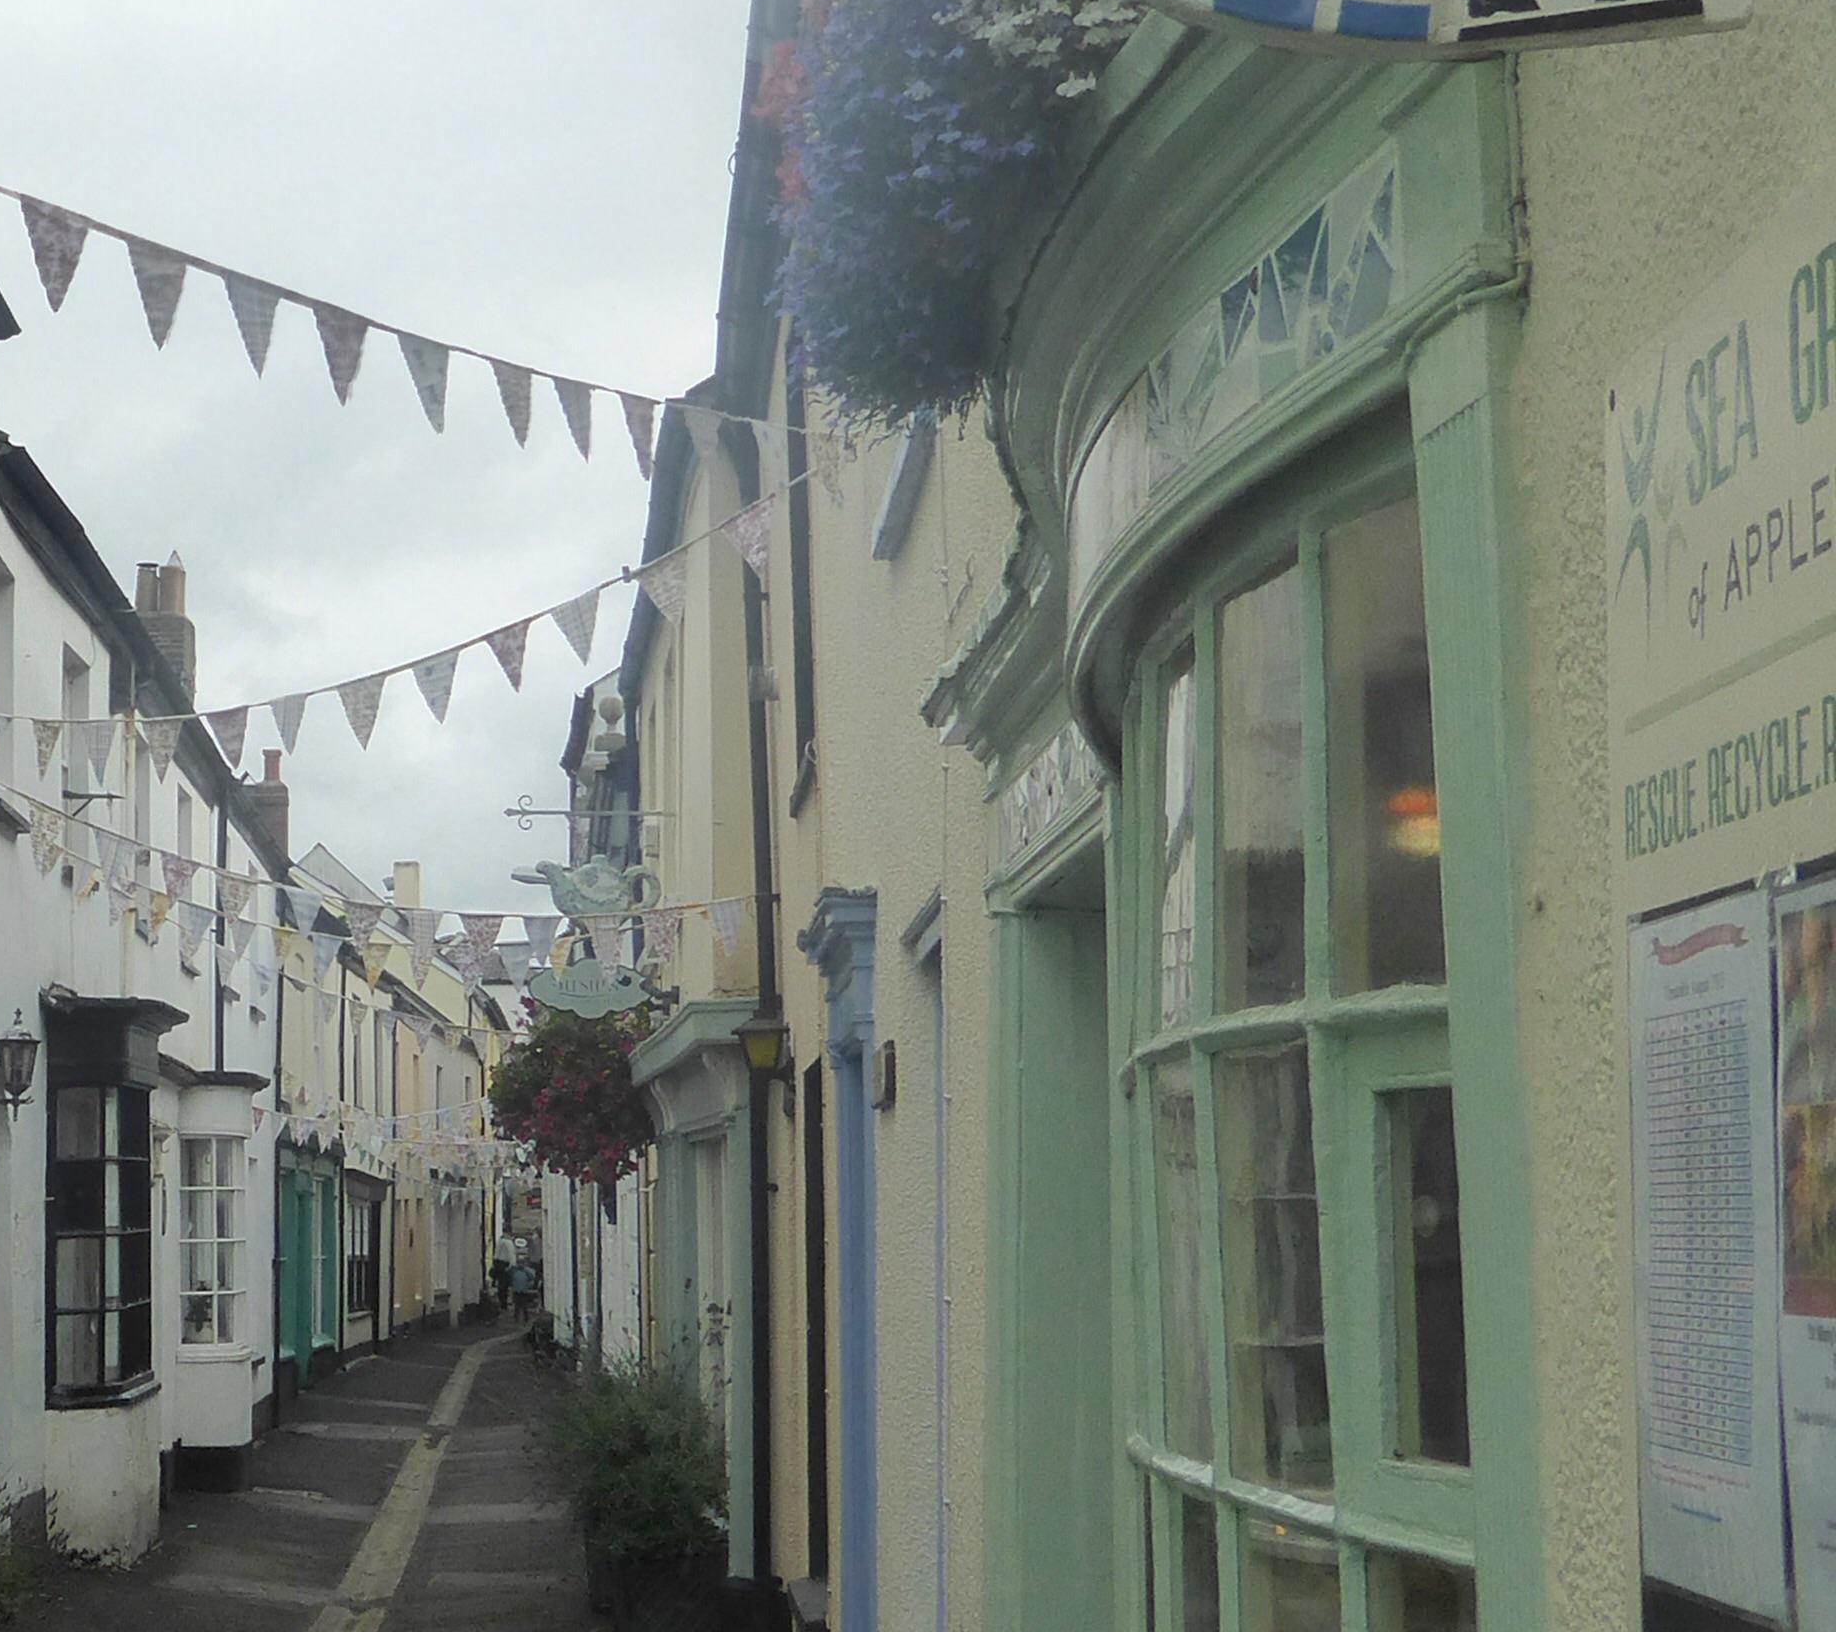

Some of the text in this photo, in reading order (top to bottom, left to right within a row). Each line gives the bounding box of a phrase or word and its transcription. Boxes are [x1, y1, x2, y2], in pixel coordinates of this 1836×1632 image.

[1684, 319, 1759, 507] SEA
[1688, 474, 1832, 641] of APPLE
